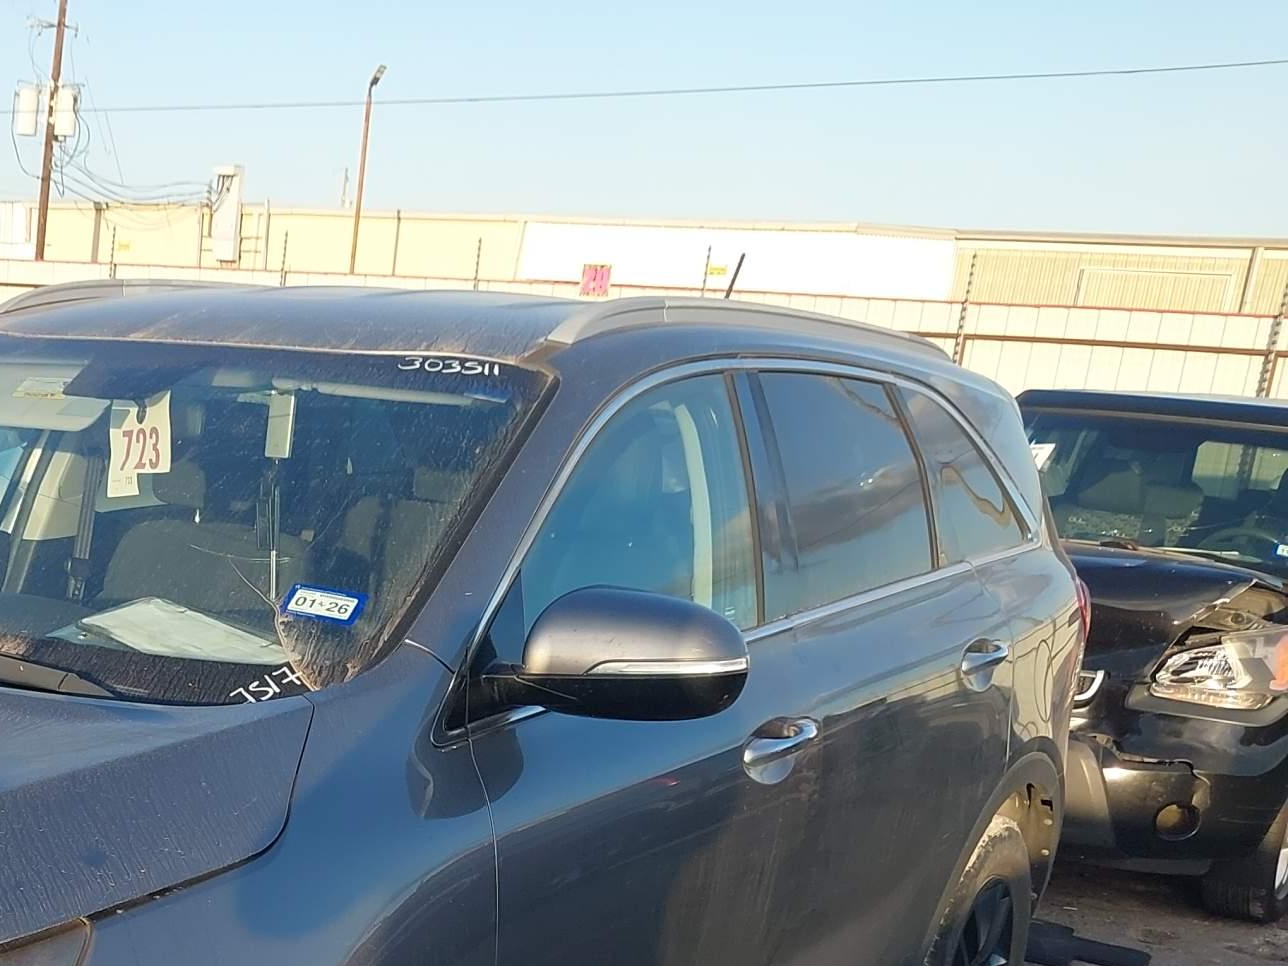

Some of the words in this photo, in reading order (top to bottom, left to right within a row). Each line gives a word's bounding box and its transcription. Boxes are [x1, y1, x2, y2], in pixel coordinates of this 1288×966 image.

[120, 426, 161, 471] 723
[294, 596, 316, 608] 01
[326, 600, 350, 615] 26
